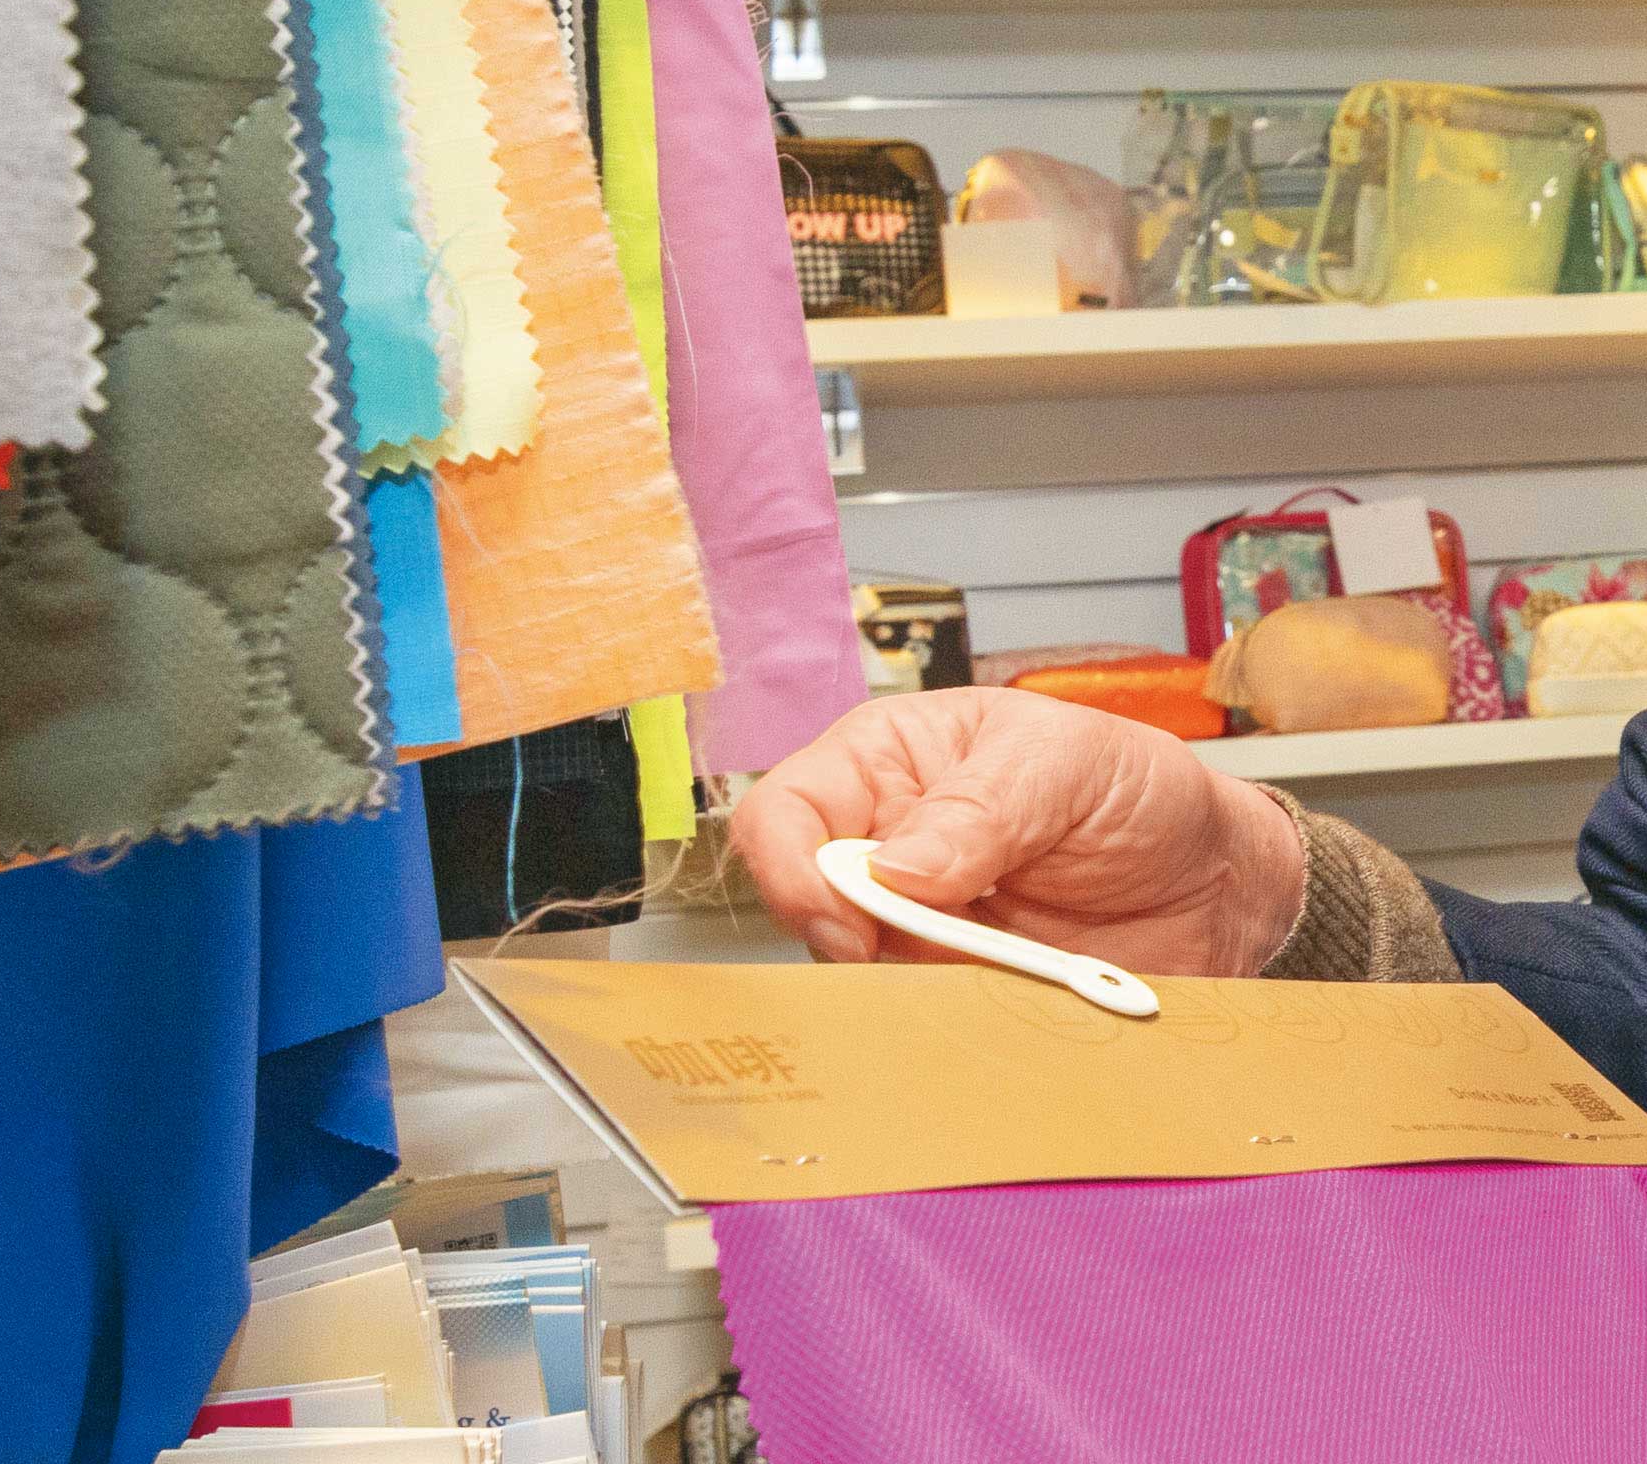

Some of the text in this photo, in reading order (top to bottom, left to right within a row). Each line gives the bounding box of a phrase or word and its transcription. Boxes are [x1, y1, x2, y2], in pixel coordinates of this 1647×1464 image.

[787, 210, 907, 243] OW UP
[622, 1034, 796, 1085] 咖啡
